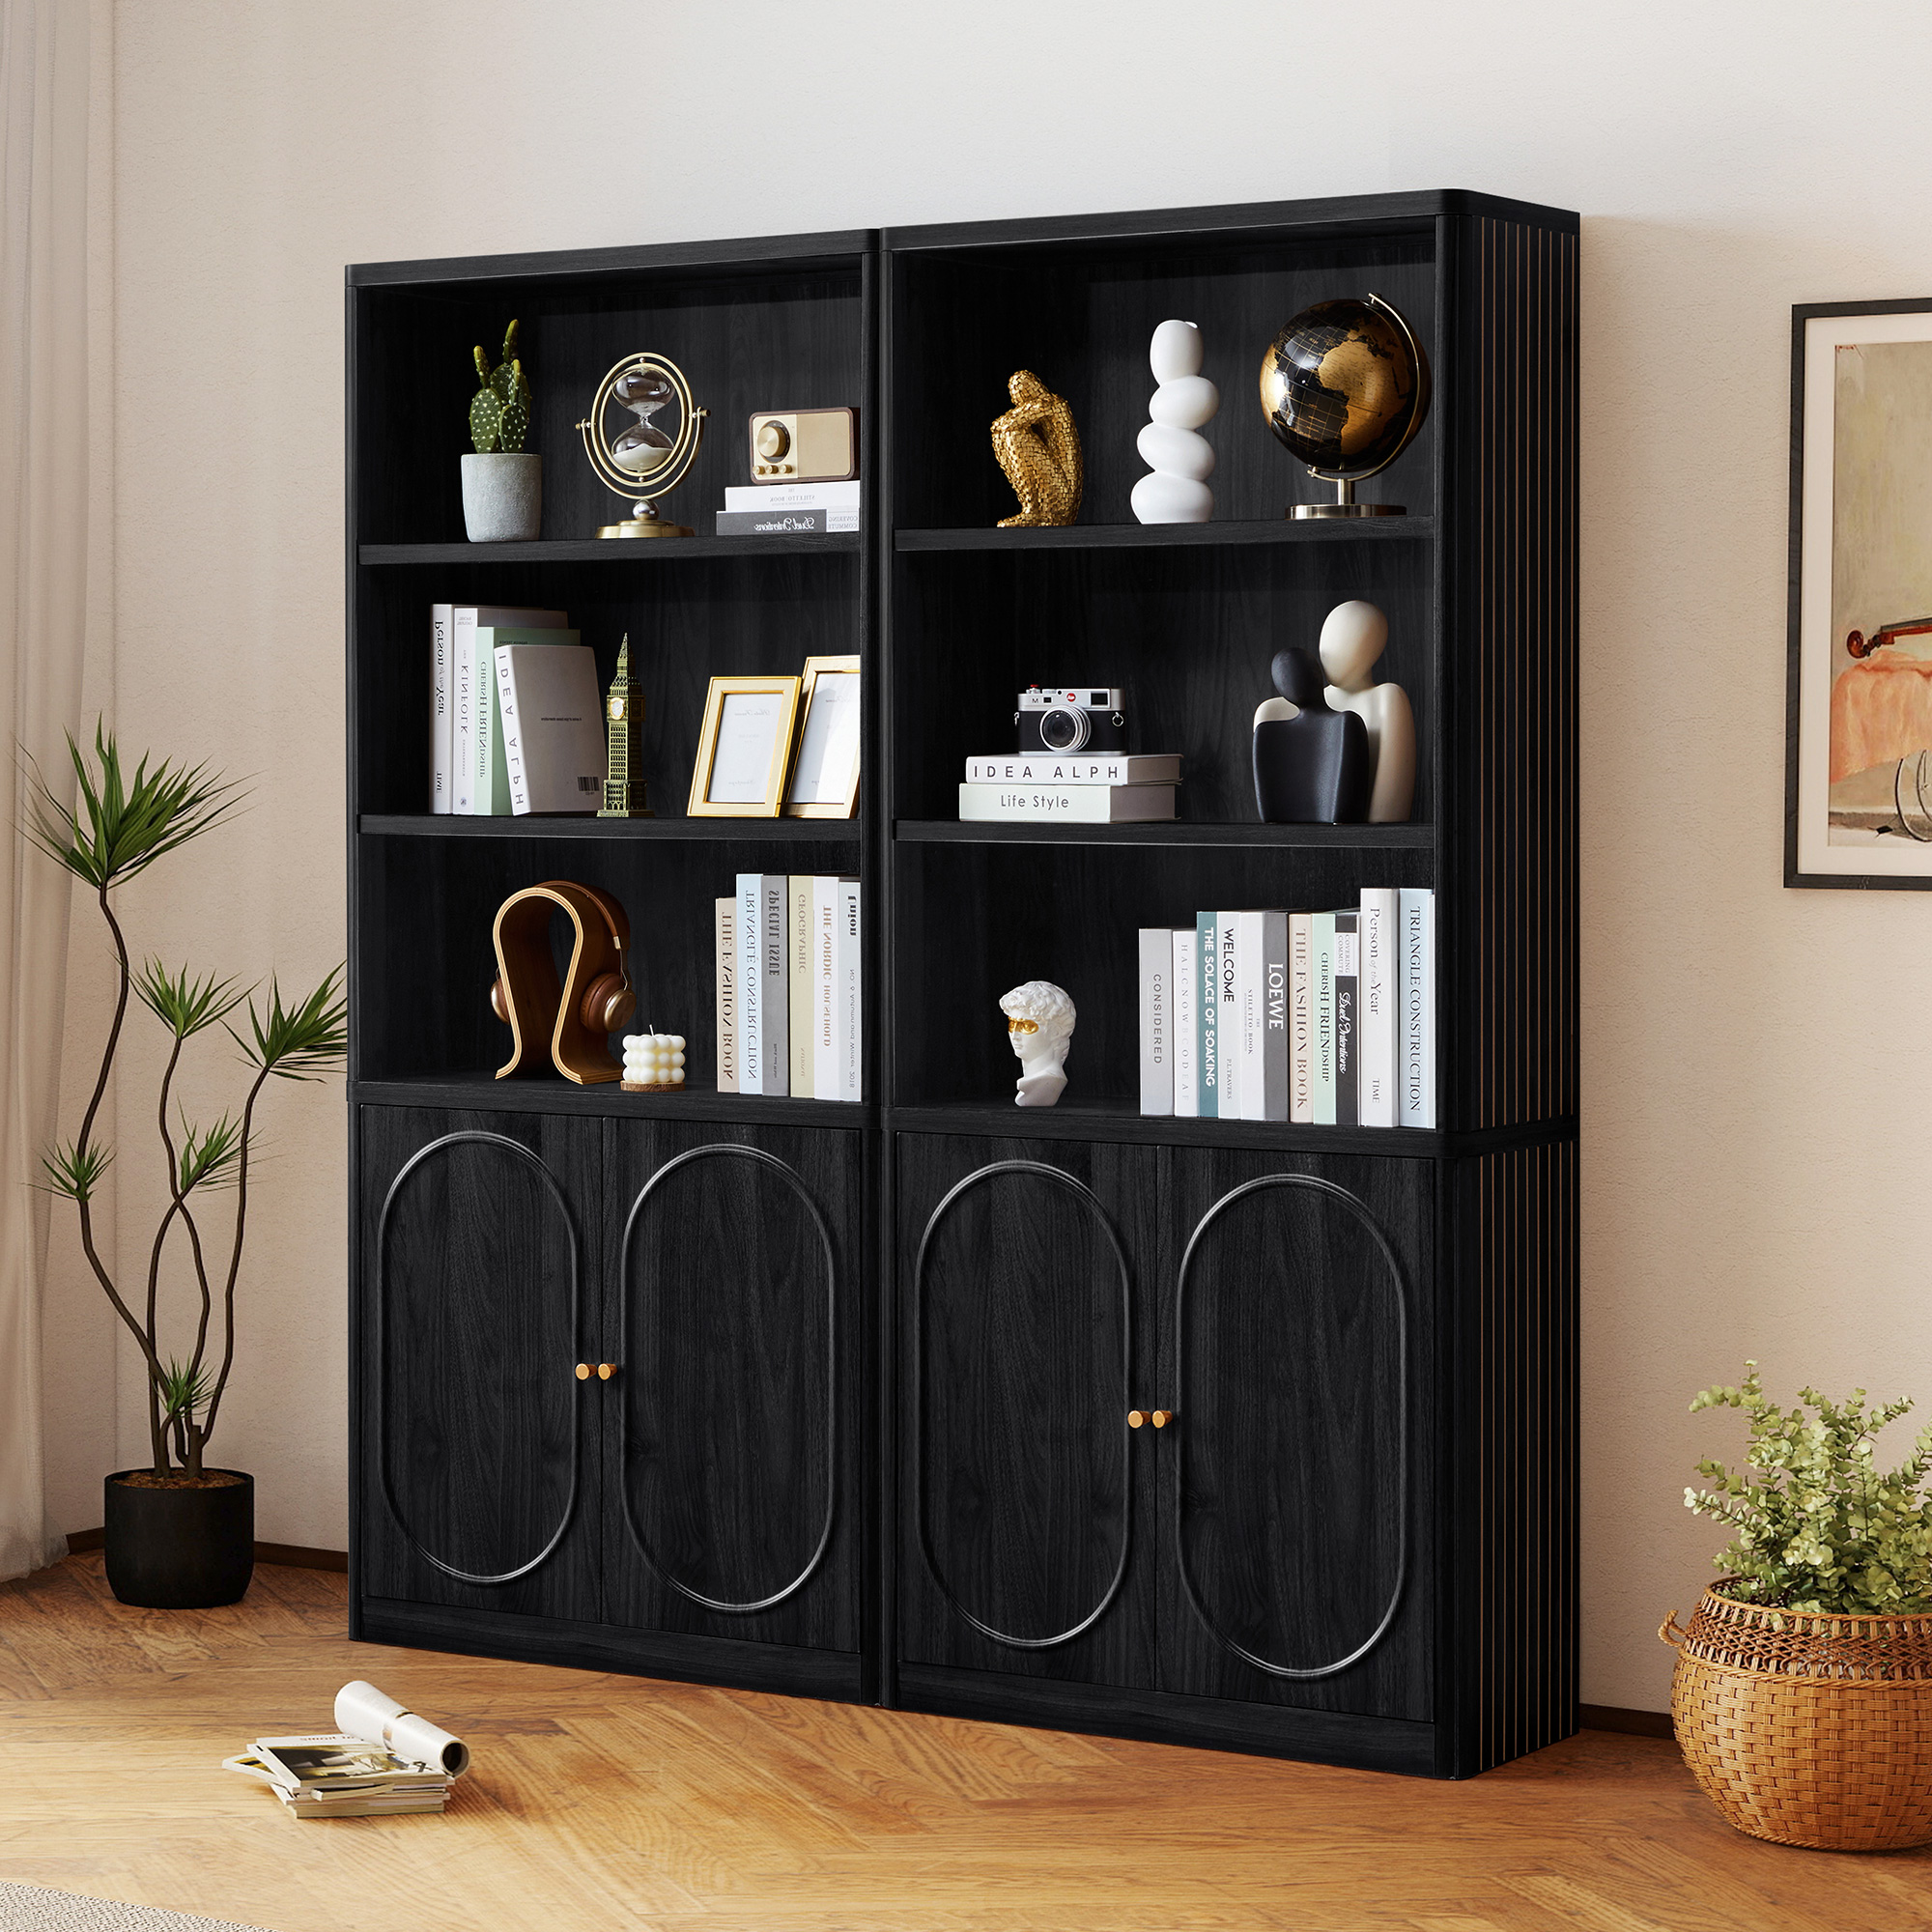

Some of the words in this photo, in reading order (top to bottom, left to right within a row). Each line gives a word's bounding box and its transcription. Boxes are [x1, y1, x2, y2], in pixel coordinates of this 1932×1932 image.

[974, 766, 1033, 779] IDEA
[1053, 766, 1119, 779] ALPH
[1001, 795, 1026, 808] Life
[1033, 795, 1069, 810] Style
[1205, 927, 1214, 952] THE
[1295, 928, 1307, 966] THE
[1369, 908, 1380, 958] Person
[1409, 906, 1421, 986] TRIANGLE
[1205, 955, 1214, 1004] SOLACE
[1223, 928, 1235, 1003] WELCOME
[1320, 952, 1329, 1002] CHERISH
[1368, 959, 1378, 970] of
[1370, 971, 1378, 984] the
[1153, 974, 1162, 1064] CONSIDERED
[1205, 1008, 1215, 1025] OF
[1268, 963, 1284, 1030] LOEWE
[1295, 972, 1307, 1053] FASHION
[1338, 991, 1351, 1022] Duel
[1370, 982, 1381, 1015] Year
[1205, 1030, 1215, 1087] SOAKING
[1320, 1007, 1330, 1083] FRIENDSHIP
[1338, 1022, 1351, 1074] Intentions
[1409, 989, 1421, 1111] CONSTRUCTION
[1296, 1059, 1308, 1109] BOOK
[1372, 1078, 1380, 1103] TIME
